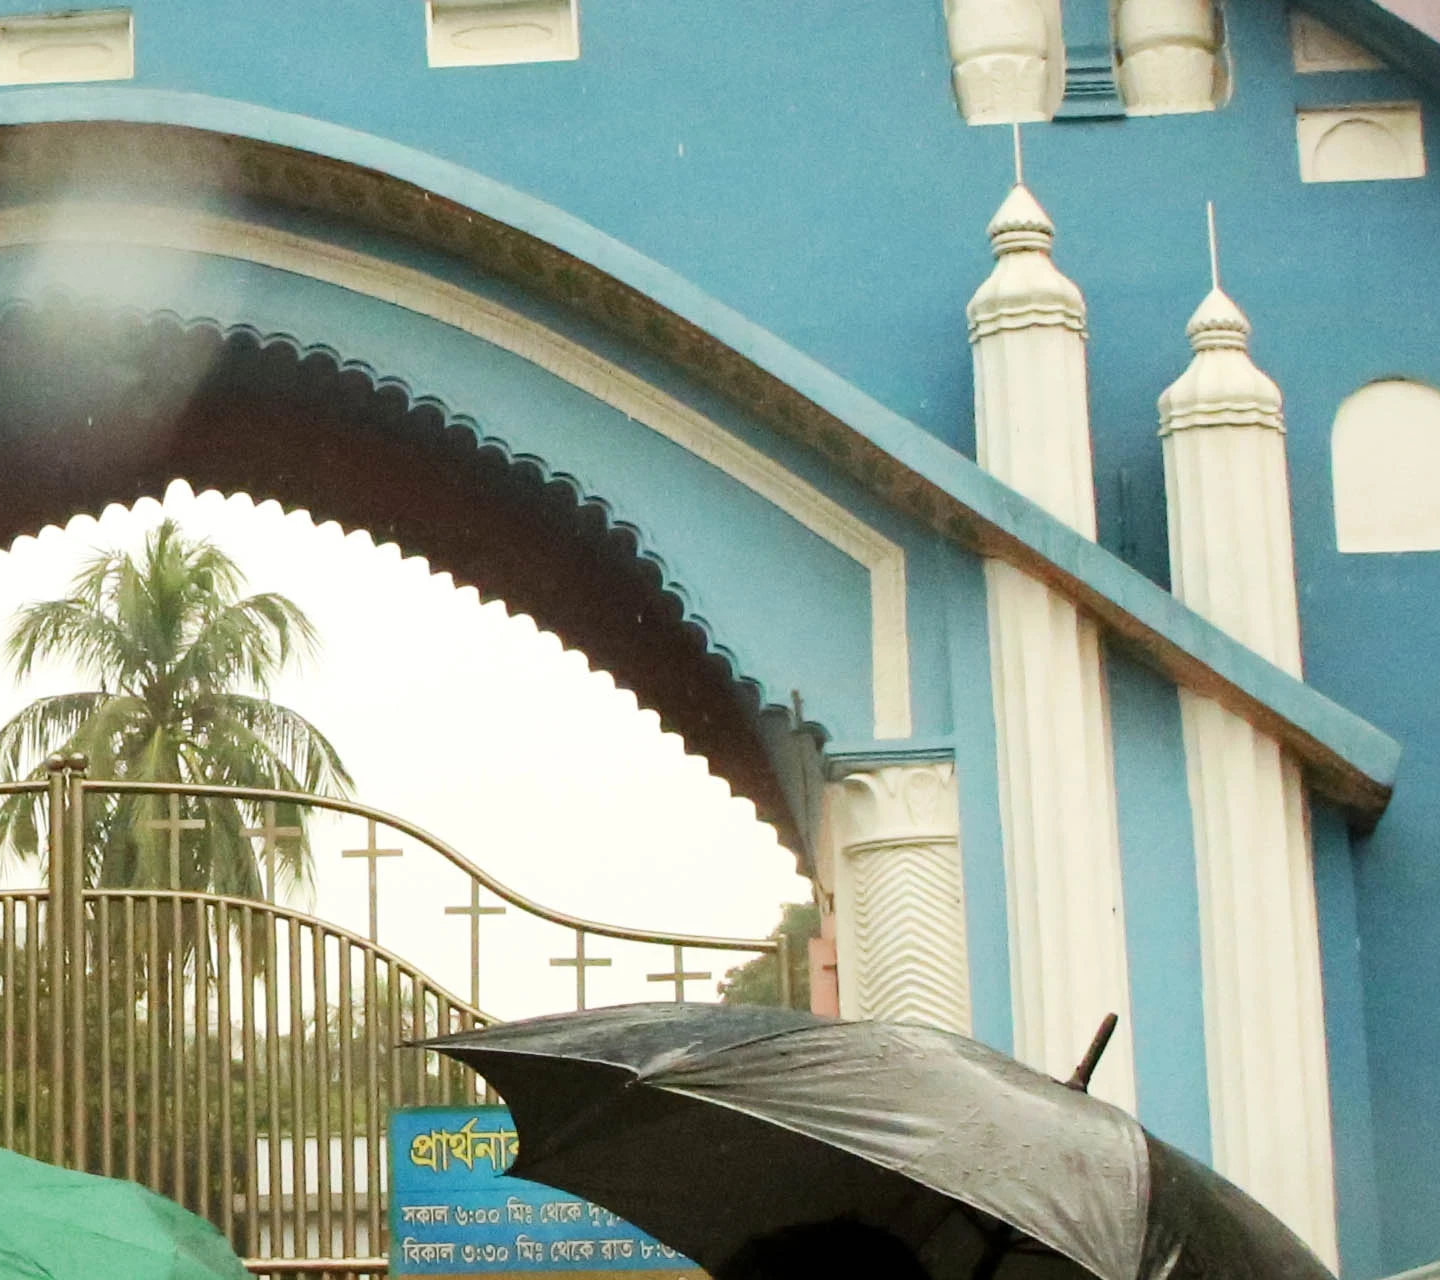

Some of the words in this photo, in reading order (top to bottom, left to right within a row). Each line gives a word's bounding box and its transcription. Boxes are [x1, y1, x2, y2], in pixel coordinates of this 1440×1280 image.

[401, 1206, 450, 1226] সকাল
[455, 1205, 500, 1226] ৬:০০
[506, 1196, 533, 1224] মিঃ
[540, 1202, 582, 1223] থেকে
[403, 1237, 455, 1264] বিকাল
[461, 1243, 509, 1263] ৩:৩০
[516, 1234, 543, 1262] মিঃ
[550, 1240, 594, 1262] থেকে
[599, 1239, 634, 1262] রাত
